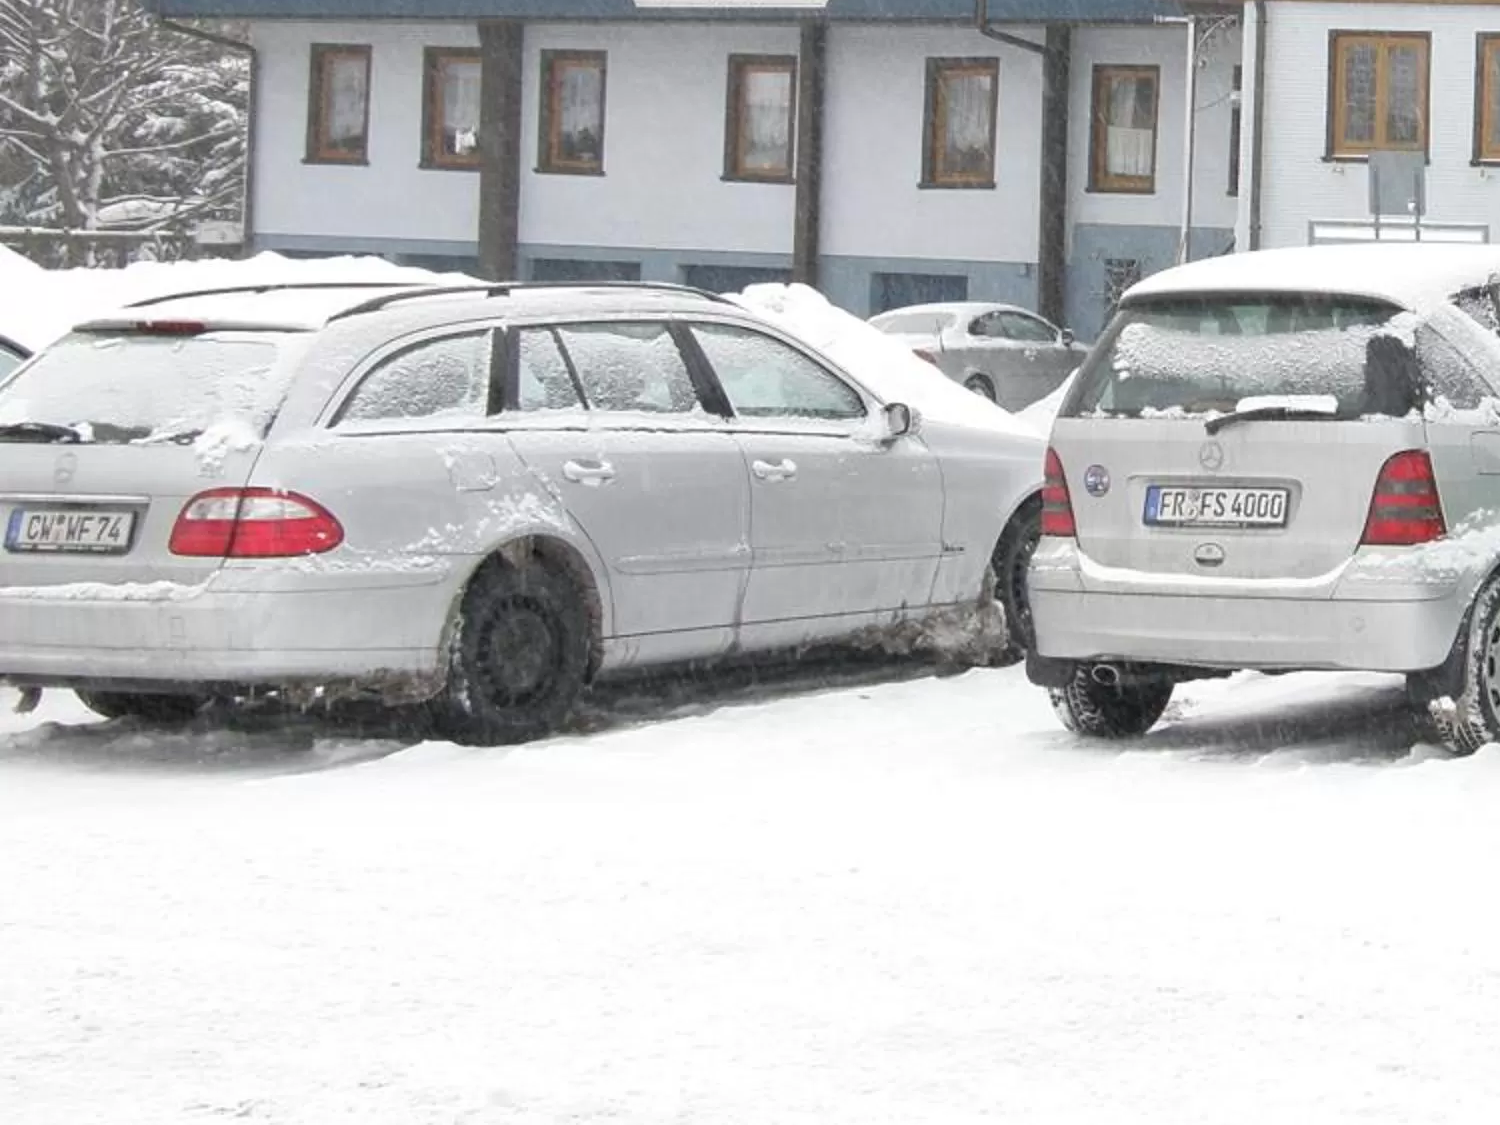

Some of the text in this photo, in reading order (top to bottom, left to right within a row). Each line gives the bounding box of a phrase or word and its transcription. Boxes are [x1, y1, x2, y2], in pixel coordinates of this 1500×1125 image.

[1160, 491, 1283, 518] FR FS 4000
[27, 514, 122, 543] CW WF 74
